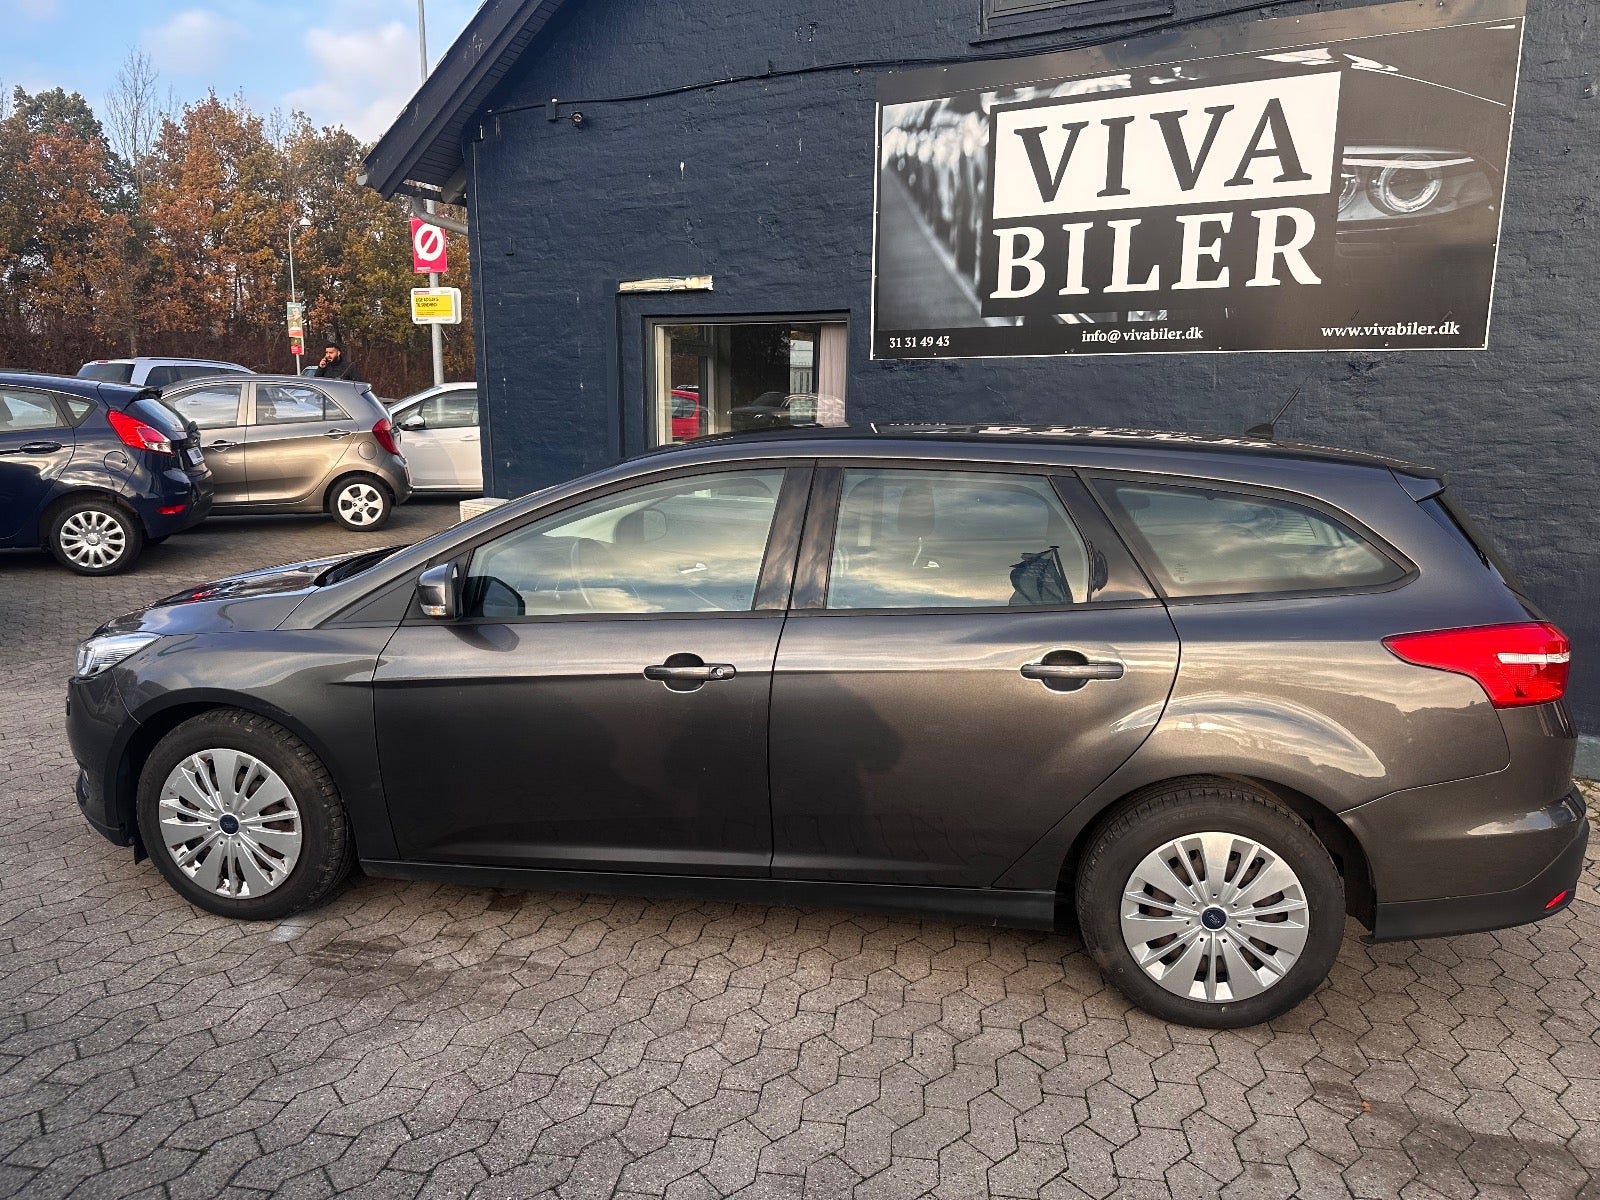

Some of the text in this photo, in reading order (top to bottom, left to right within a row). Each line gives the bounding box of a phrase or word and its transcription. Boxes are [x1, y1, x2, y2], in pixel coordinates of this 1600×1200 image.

[1013, 98, 1312, 203] VIVA
[990, 207, 1322, 299] BILER
[889, 335, 950, 348] 31 31 49 43
[1320, 321, 1460, 337] www.vivabiler.dk
